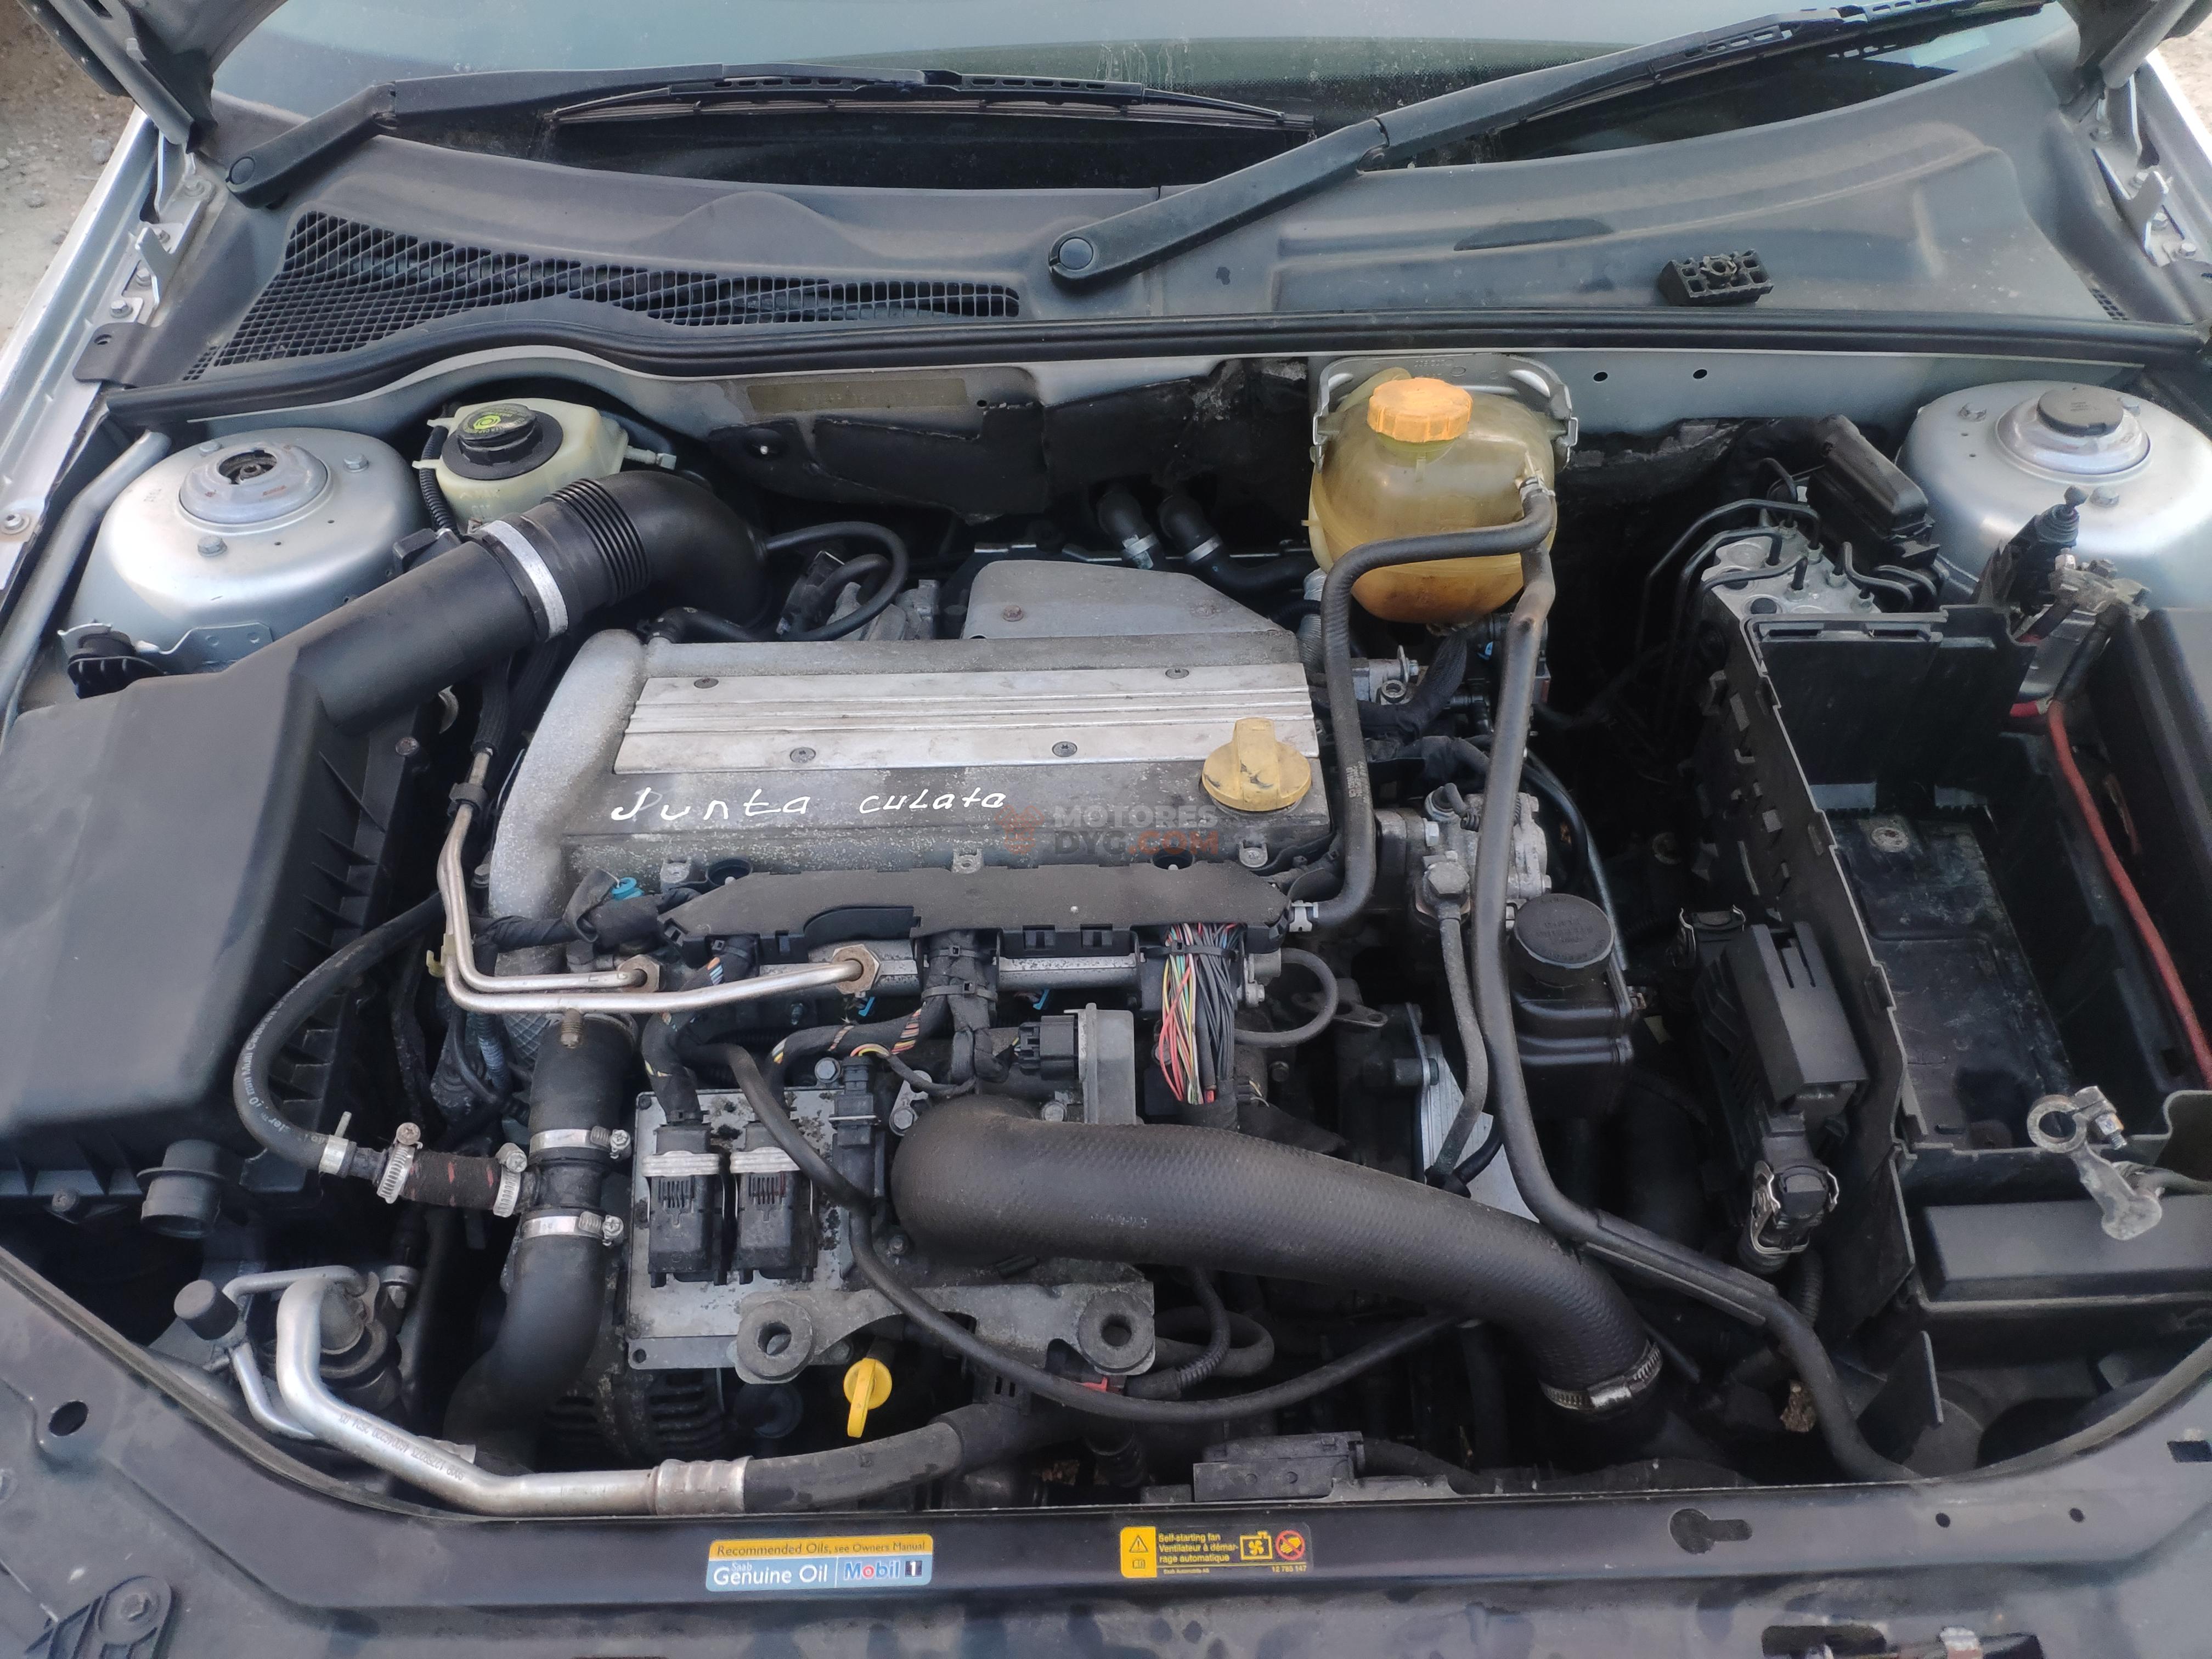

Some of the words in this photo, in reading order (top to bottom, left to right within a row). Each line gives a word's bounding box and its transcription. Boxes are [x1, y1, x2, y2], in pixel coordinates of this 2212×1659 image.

[1158, 1533, 1206, 1543] Self-starting
[1208, 1532, 1221, 1542] fan
[717, 1543, 802, 1556] Recommended
[806, 1543, 831, 1554] Oils,
[893, 1541, 925, 1551] Manual
[1159, 1544, 1201, 1553] Ventilateur
[1159, 1555, 1178, 1564] rage
[1180, 1554, 1230, 1563] automatique
[731, 1562, 753, 1572] Saab
[843, 1560, 901, 1581] Mobil
[714, 1566, 792, 1585] Genuine
[799, 1564, 827, 1583] Oil
